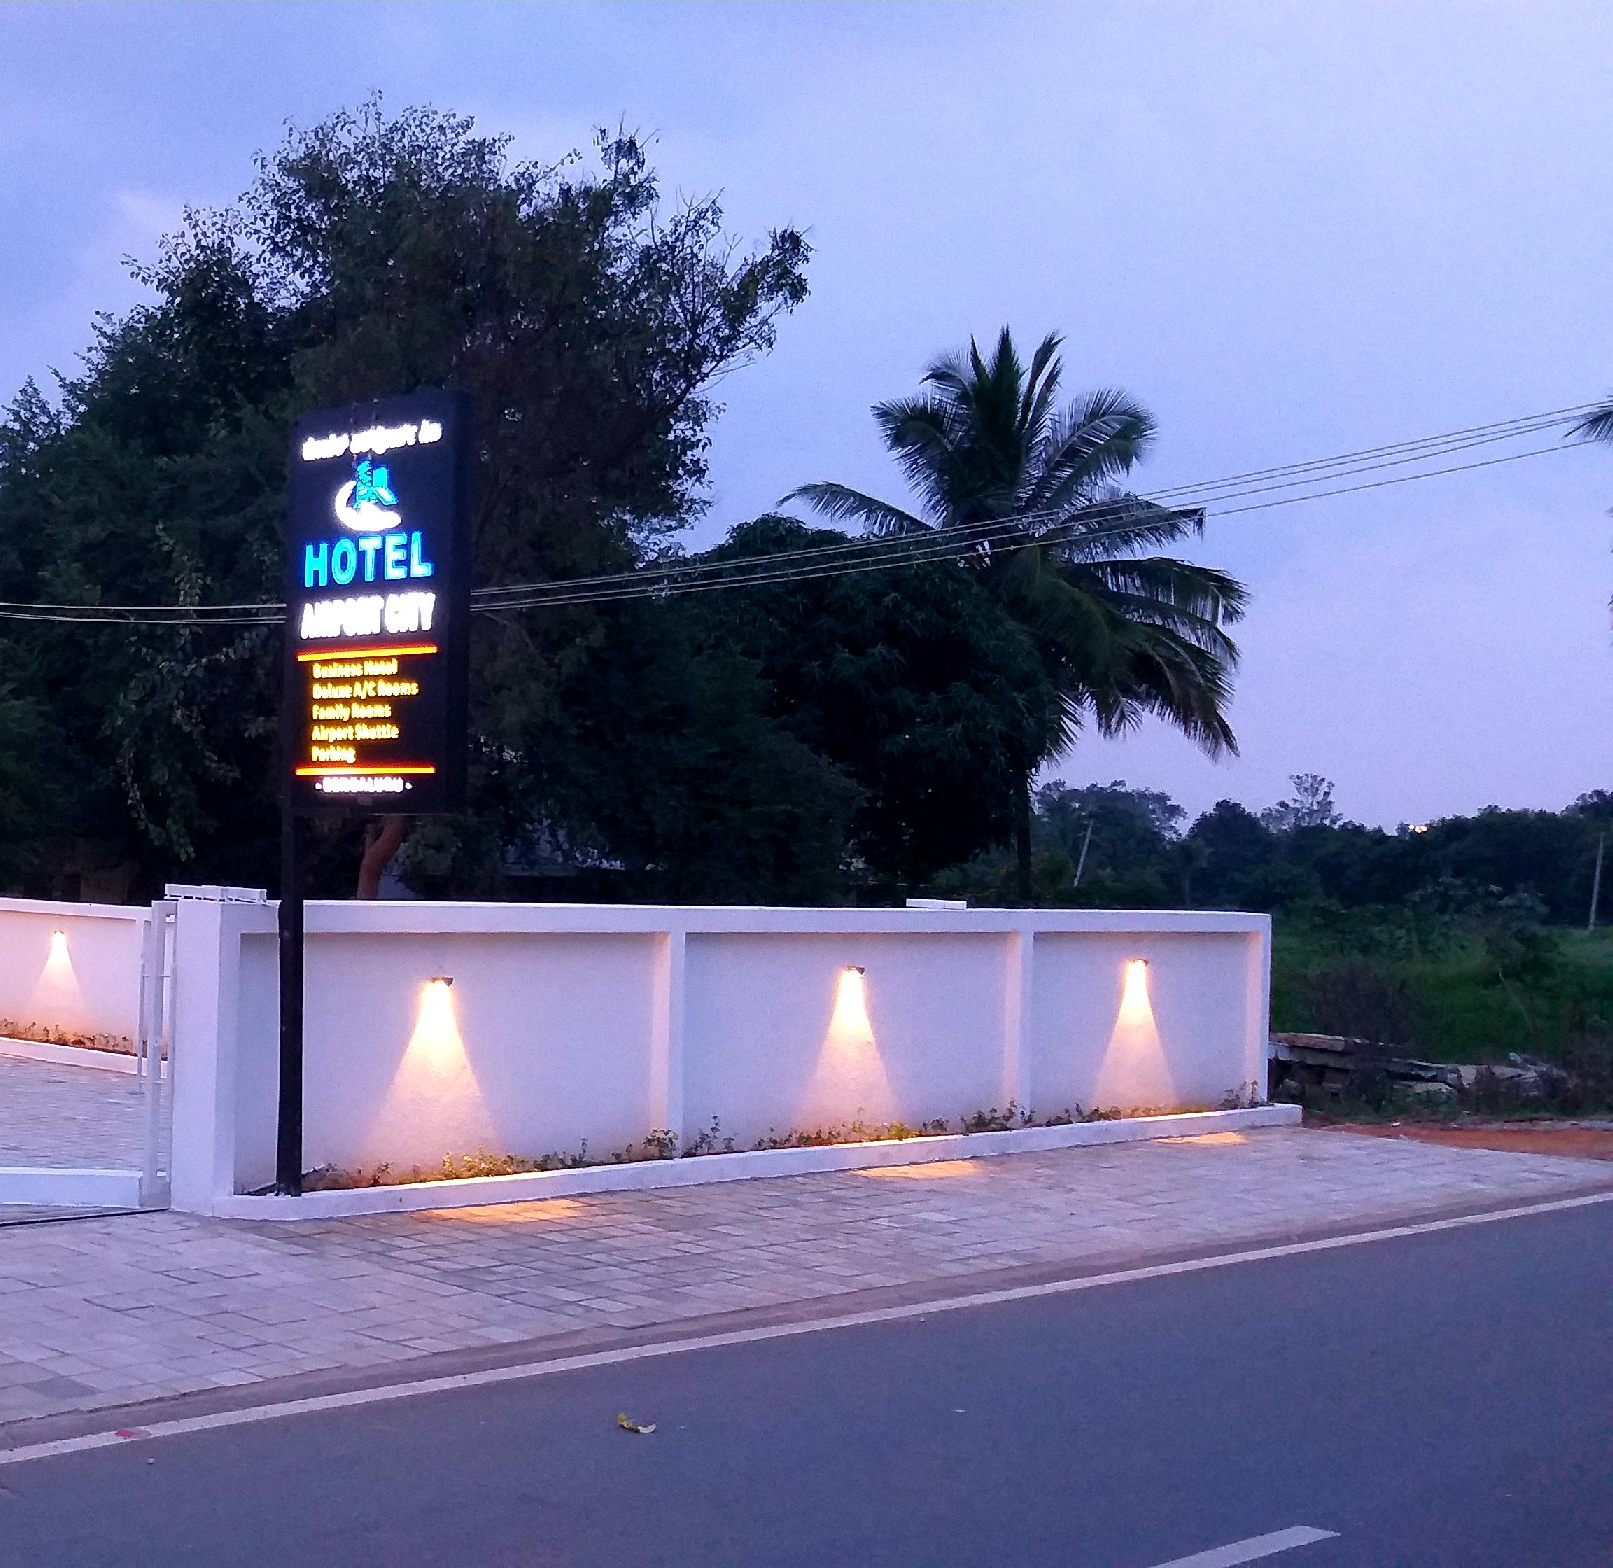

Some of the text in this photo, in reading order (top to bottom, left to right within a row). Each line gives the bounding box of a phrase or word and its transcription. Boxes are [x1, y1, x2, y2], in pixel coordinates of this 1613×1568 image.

[304, 531, 434, 587] HOTEL
[385, 591, 436, 634] CITY
[312, 658, 398, 678] Business Hotel
[312, 679, 419, 699] Deluxe A/C Rooms
[312, 702, 392, 721] Family Rooms
[311, 723, 400, 742] Airport Shuttle
[311, 746, 356, 763] Parking
